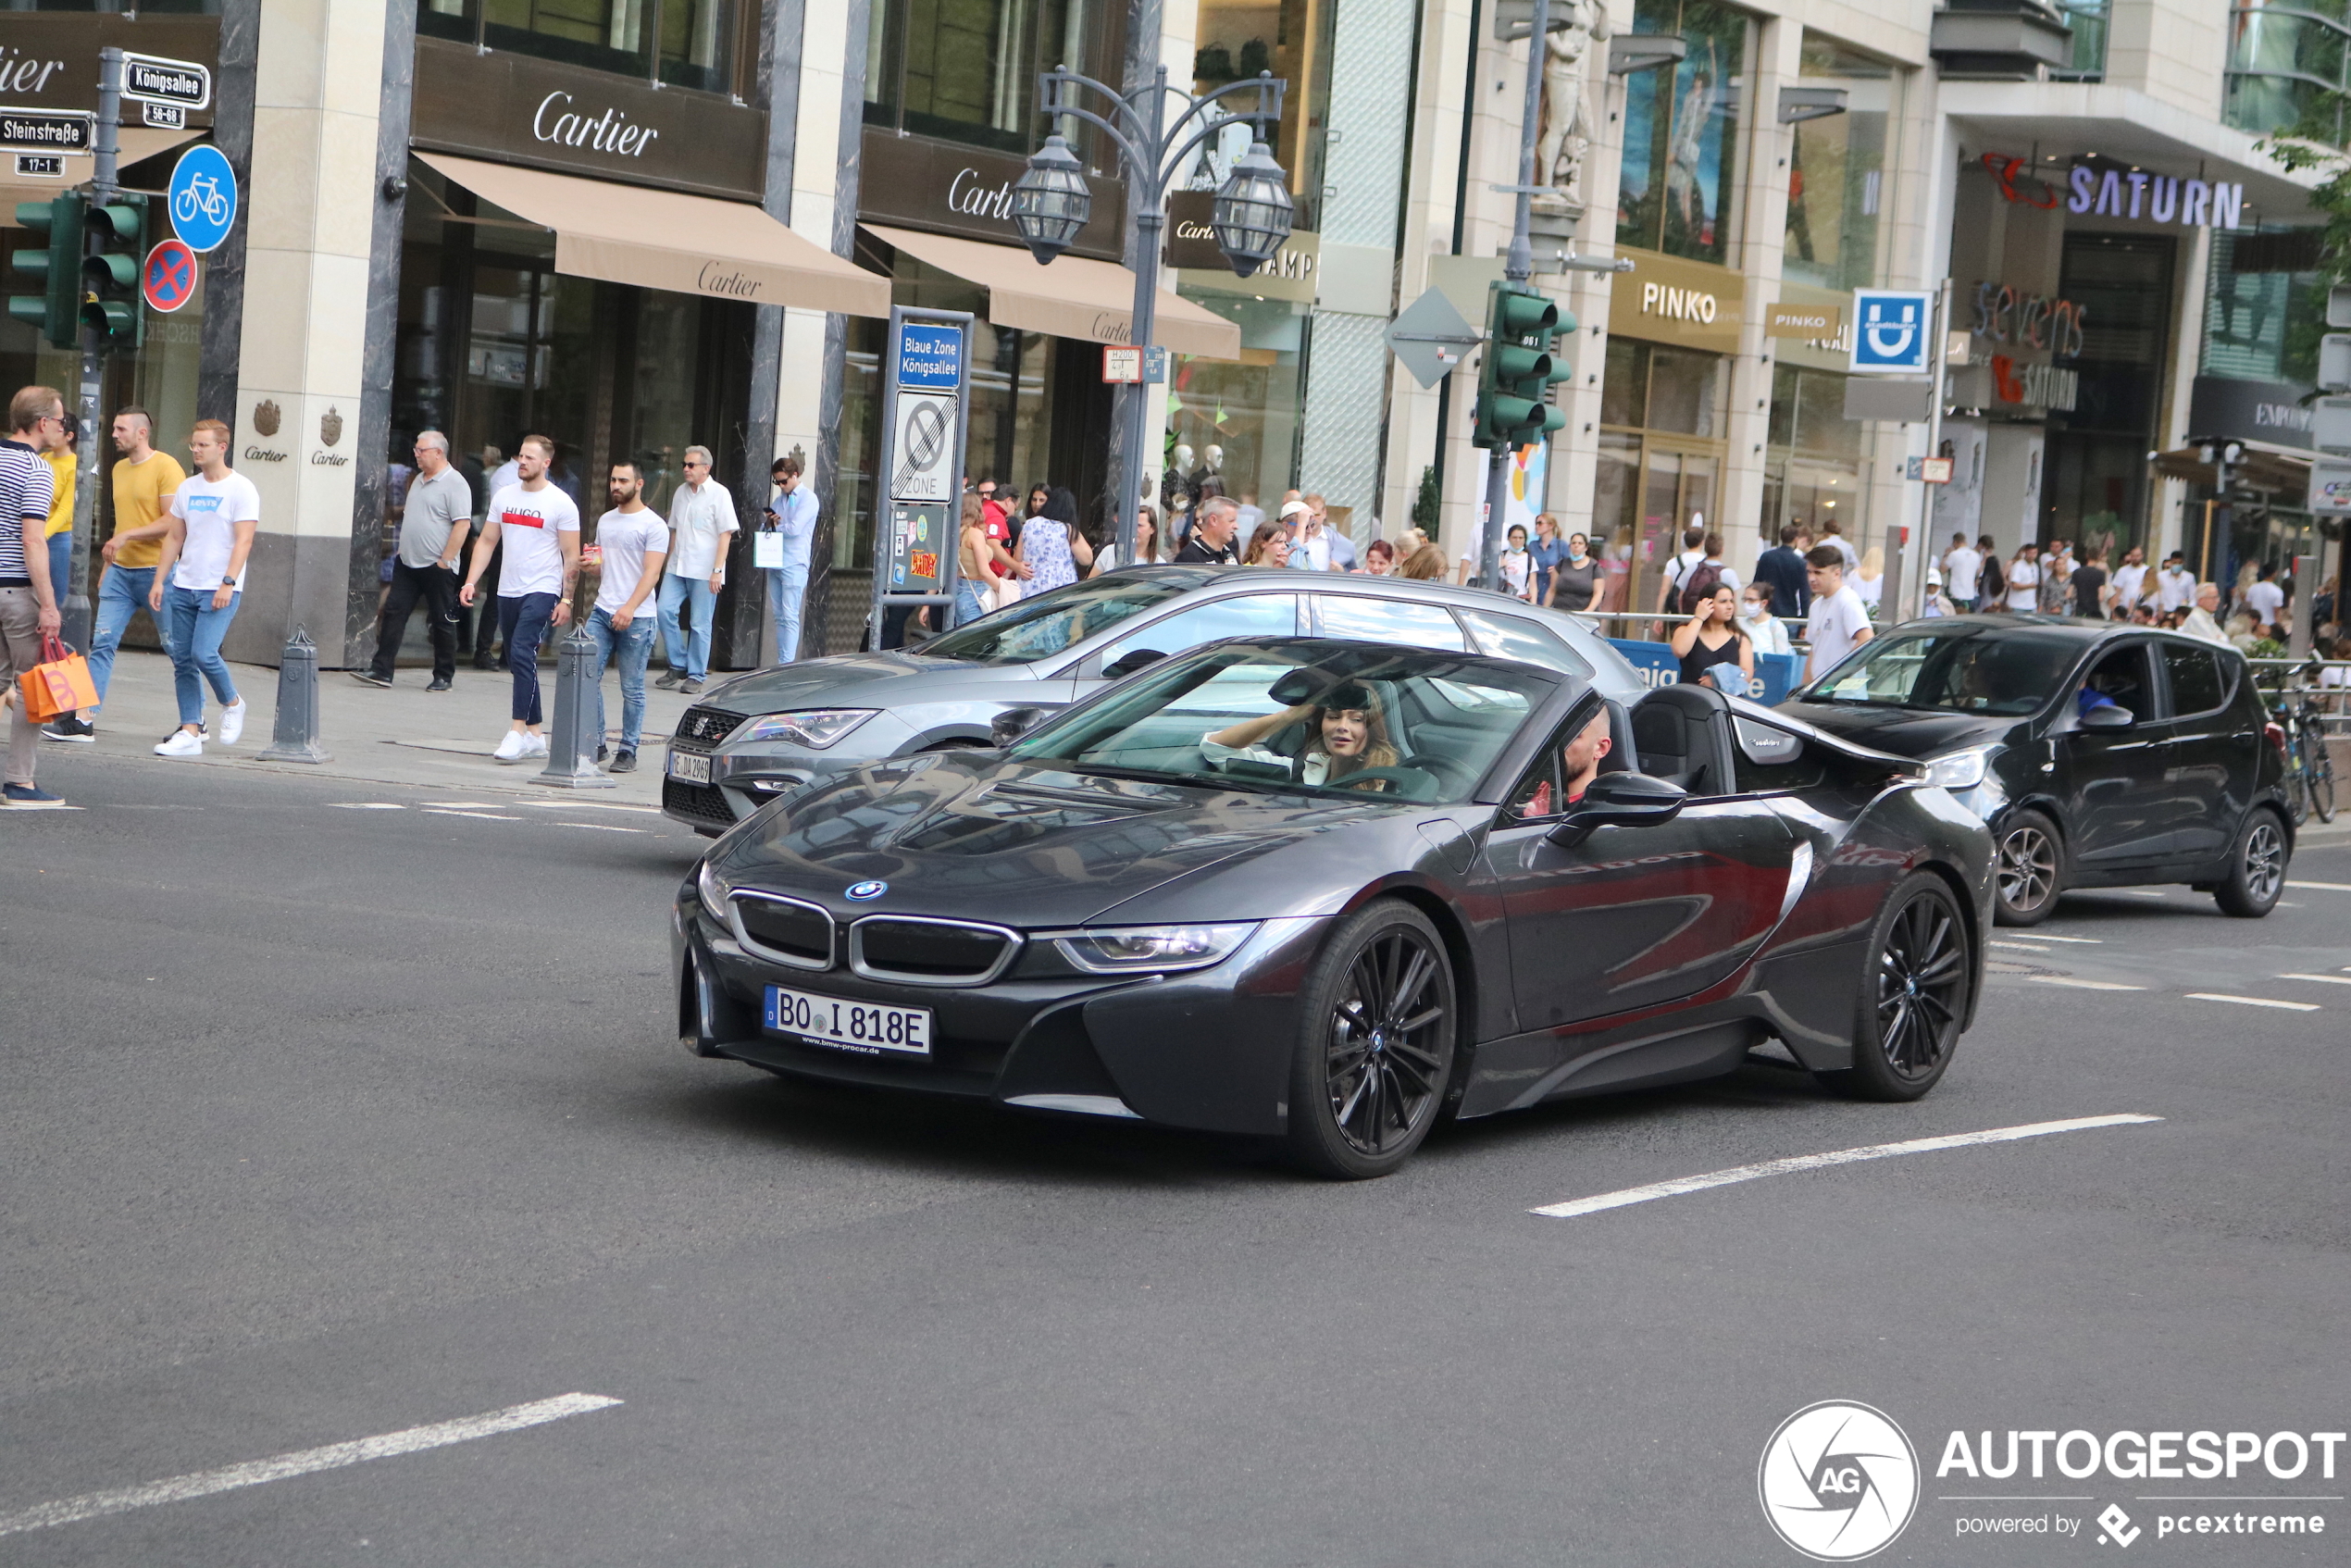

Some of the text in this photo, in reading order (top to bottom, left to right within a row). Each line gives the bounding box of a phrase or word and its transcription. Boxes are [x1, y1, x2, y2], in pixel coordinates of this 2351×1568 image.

[135, 67, 199, 95] Königsallee
[153, 108, 177, 122] 56-68
[533, 91, 658, 157] Cartier
[4, 119, 80, 144] Steinstraße
[29, 157, 51, 172] 17-1
[2068, 166, 2243, 230] SATURN
[698, 260, 762, 297] Cartier
[1643, 281, 1716, 324] PINKO
[1092, 311, 1133, 342] Cartie
[1774, 314, 1826, 328] PINKO
[904, 336, 956, 355] Blaue Zone
[1523, 335, 1539, 347] 061
[902, 357, 956, 377] Königsallee
[244, 445, 288, 463] Cartier
[311, 450, 349, 467] Cartier
[905, 477, 938, 495] ZONE
[692, 758, 710, 780] 2969
[767, 1010, 775, 1021] D
[780, 993, 924, 1048] BO I 818E
[802, 1036, 880, 1055] www.bmw-procar.de
